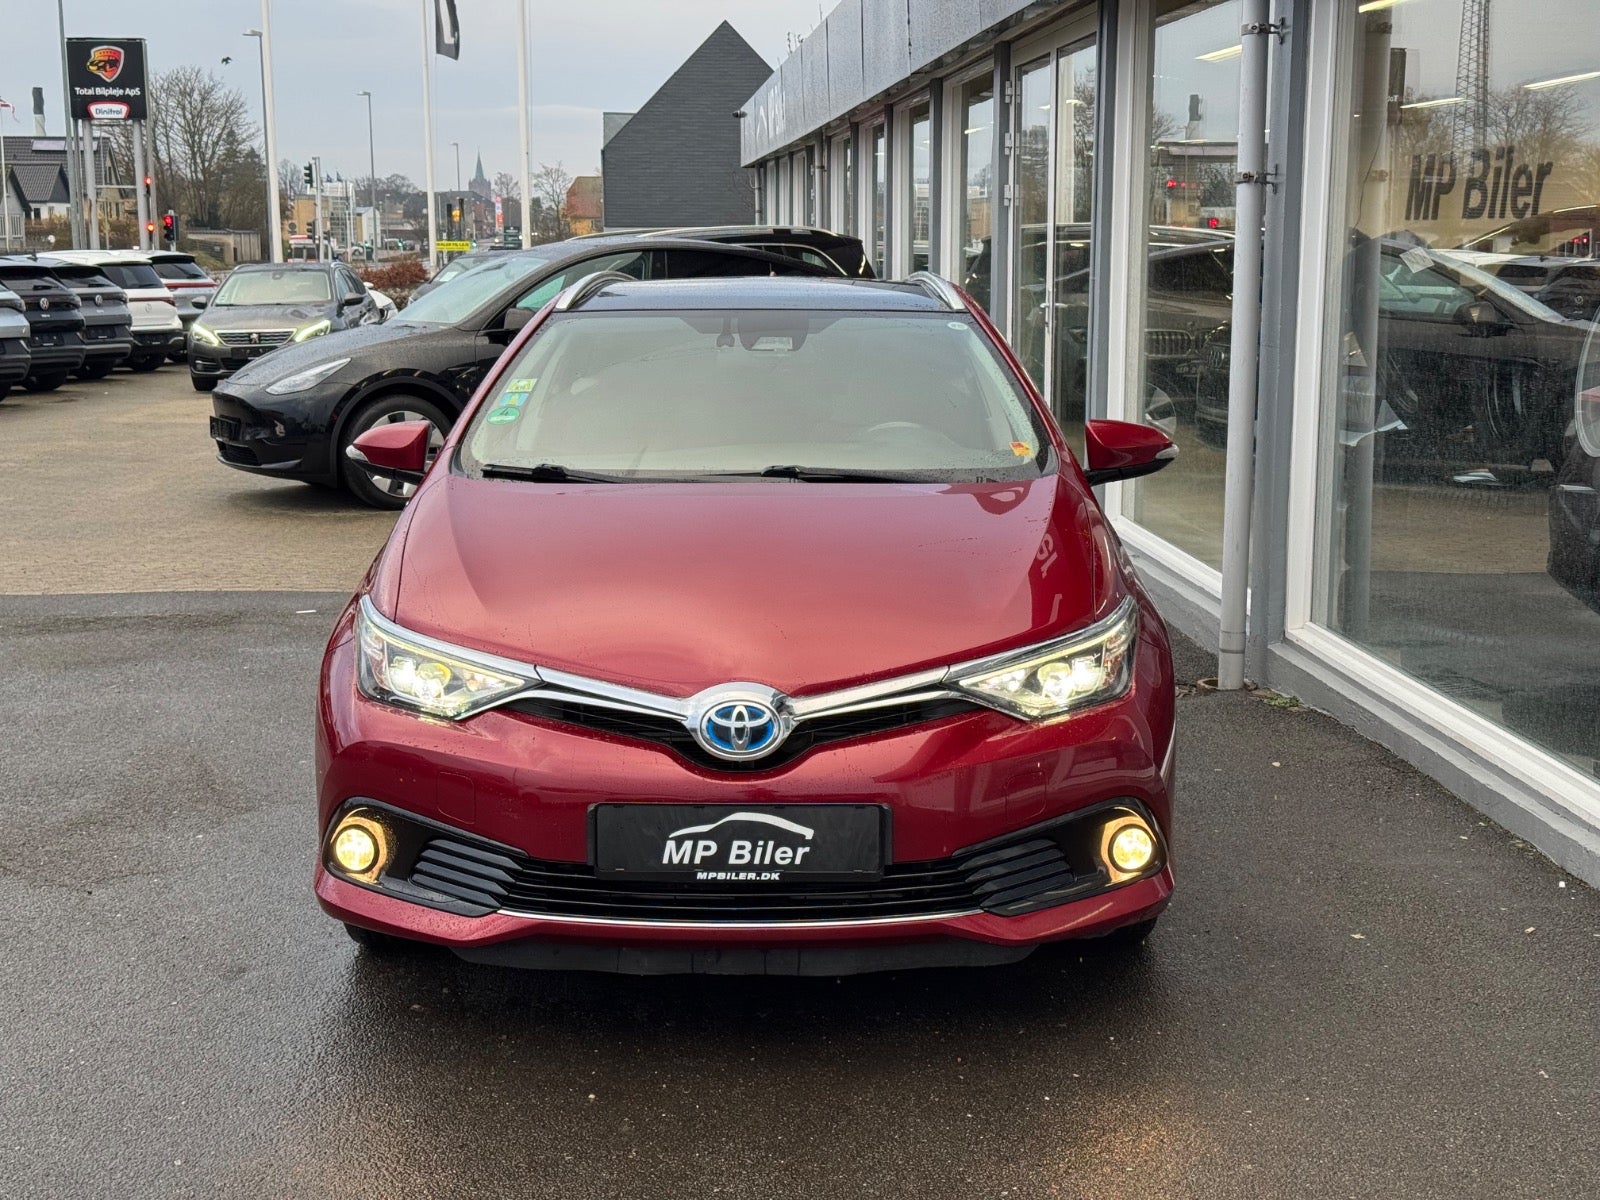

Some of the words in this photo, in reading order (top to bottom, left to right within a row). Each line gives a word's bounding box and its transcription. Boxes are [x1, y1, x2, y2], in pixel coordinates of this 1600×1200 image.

[75, 87, 94, 95] Total
[95, 87, 123, 96] Bilpleje
[125, 87, 141, 96] ApS
[1405, 151, 1456, 220] MP
[1462, 146, 1553, 219] Biler
[662, 839, 718, 865] MP
[728, 839, 811, 865] Biler
[696, 871, 780, 881] MPBILER.DK
